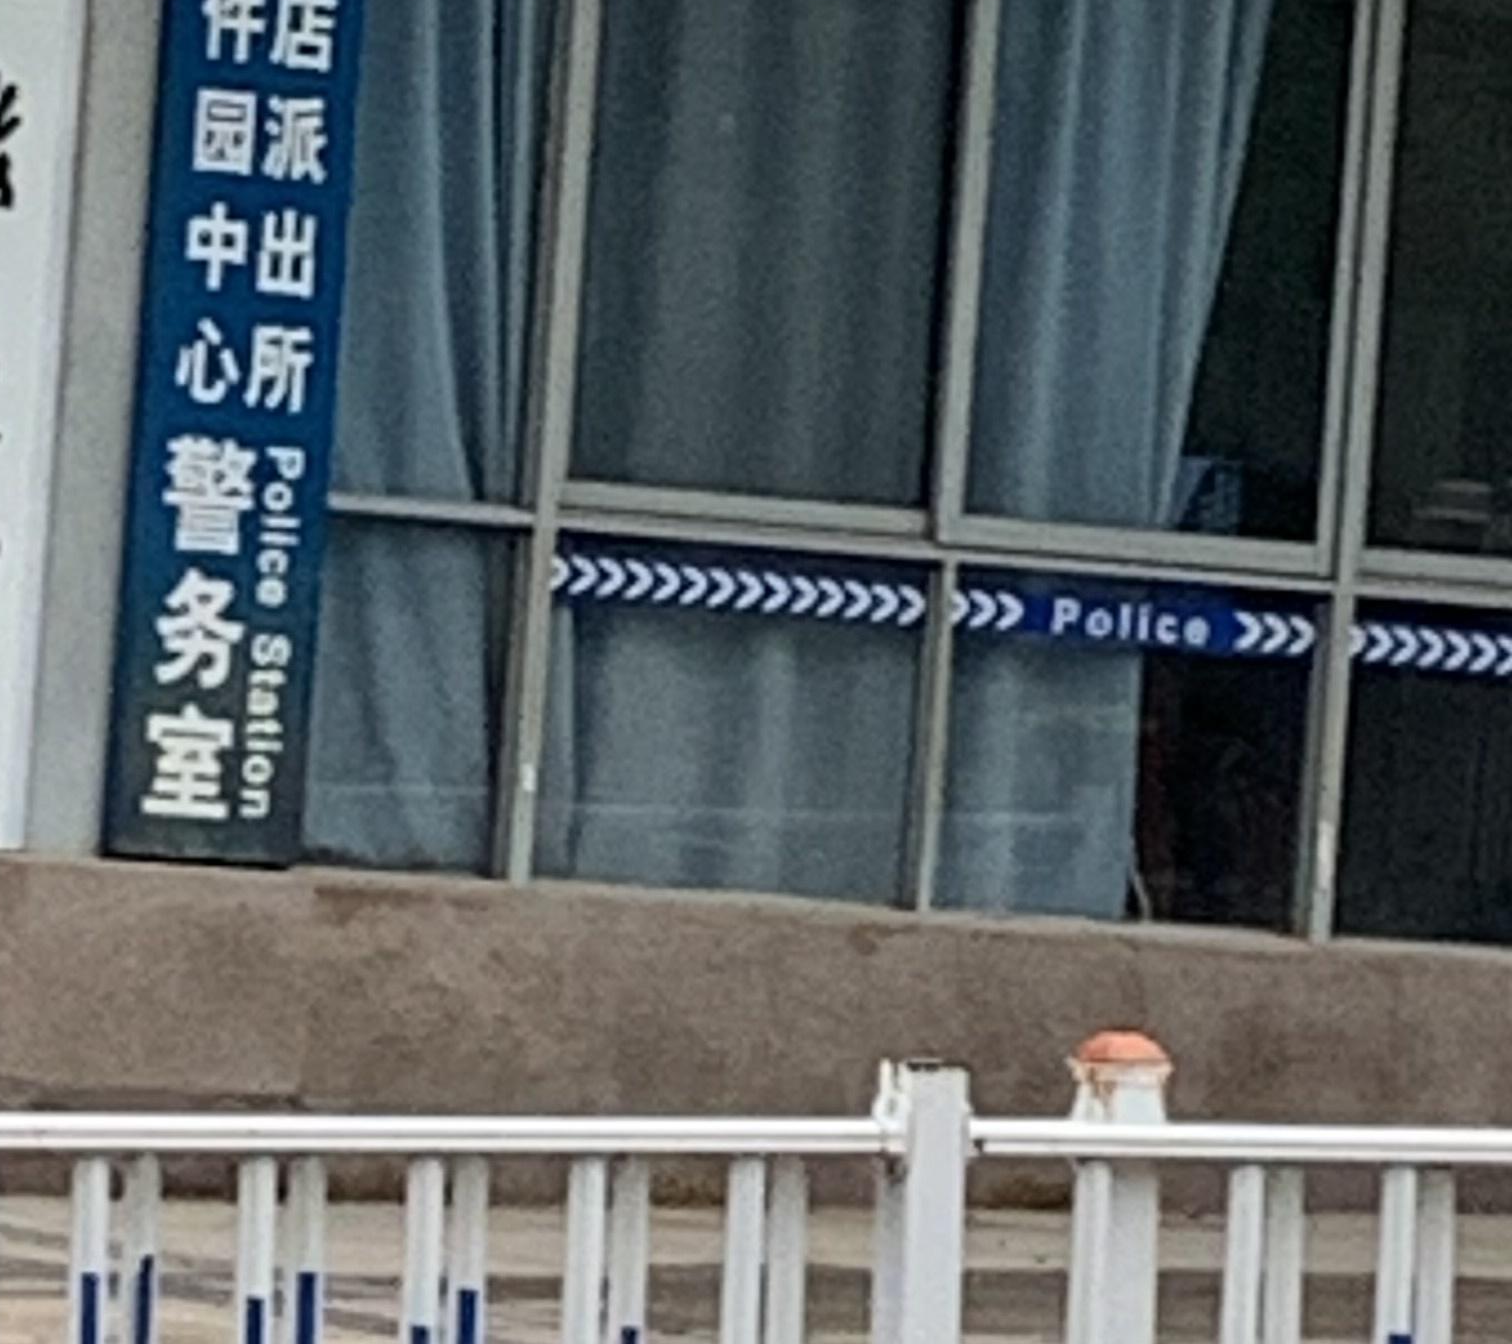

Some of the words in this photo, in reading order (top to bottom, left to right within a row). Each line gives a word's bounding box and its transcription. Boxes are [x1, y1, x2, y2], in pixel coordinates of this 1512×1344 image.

[255, 444, 306, 608] Police
[139, 434, 258, 822] 警务室
[1050, 597, 1212, 649] Police
[238, 632, 292, 820] Station
